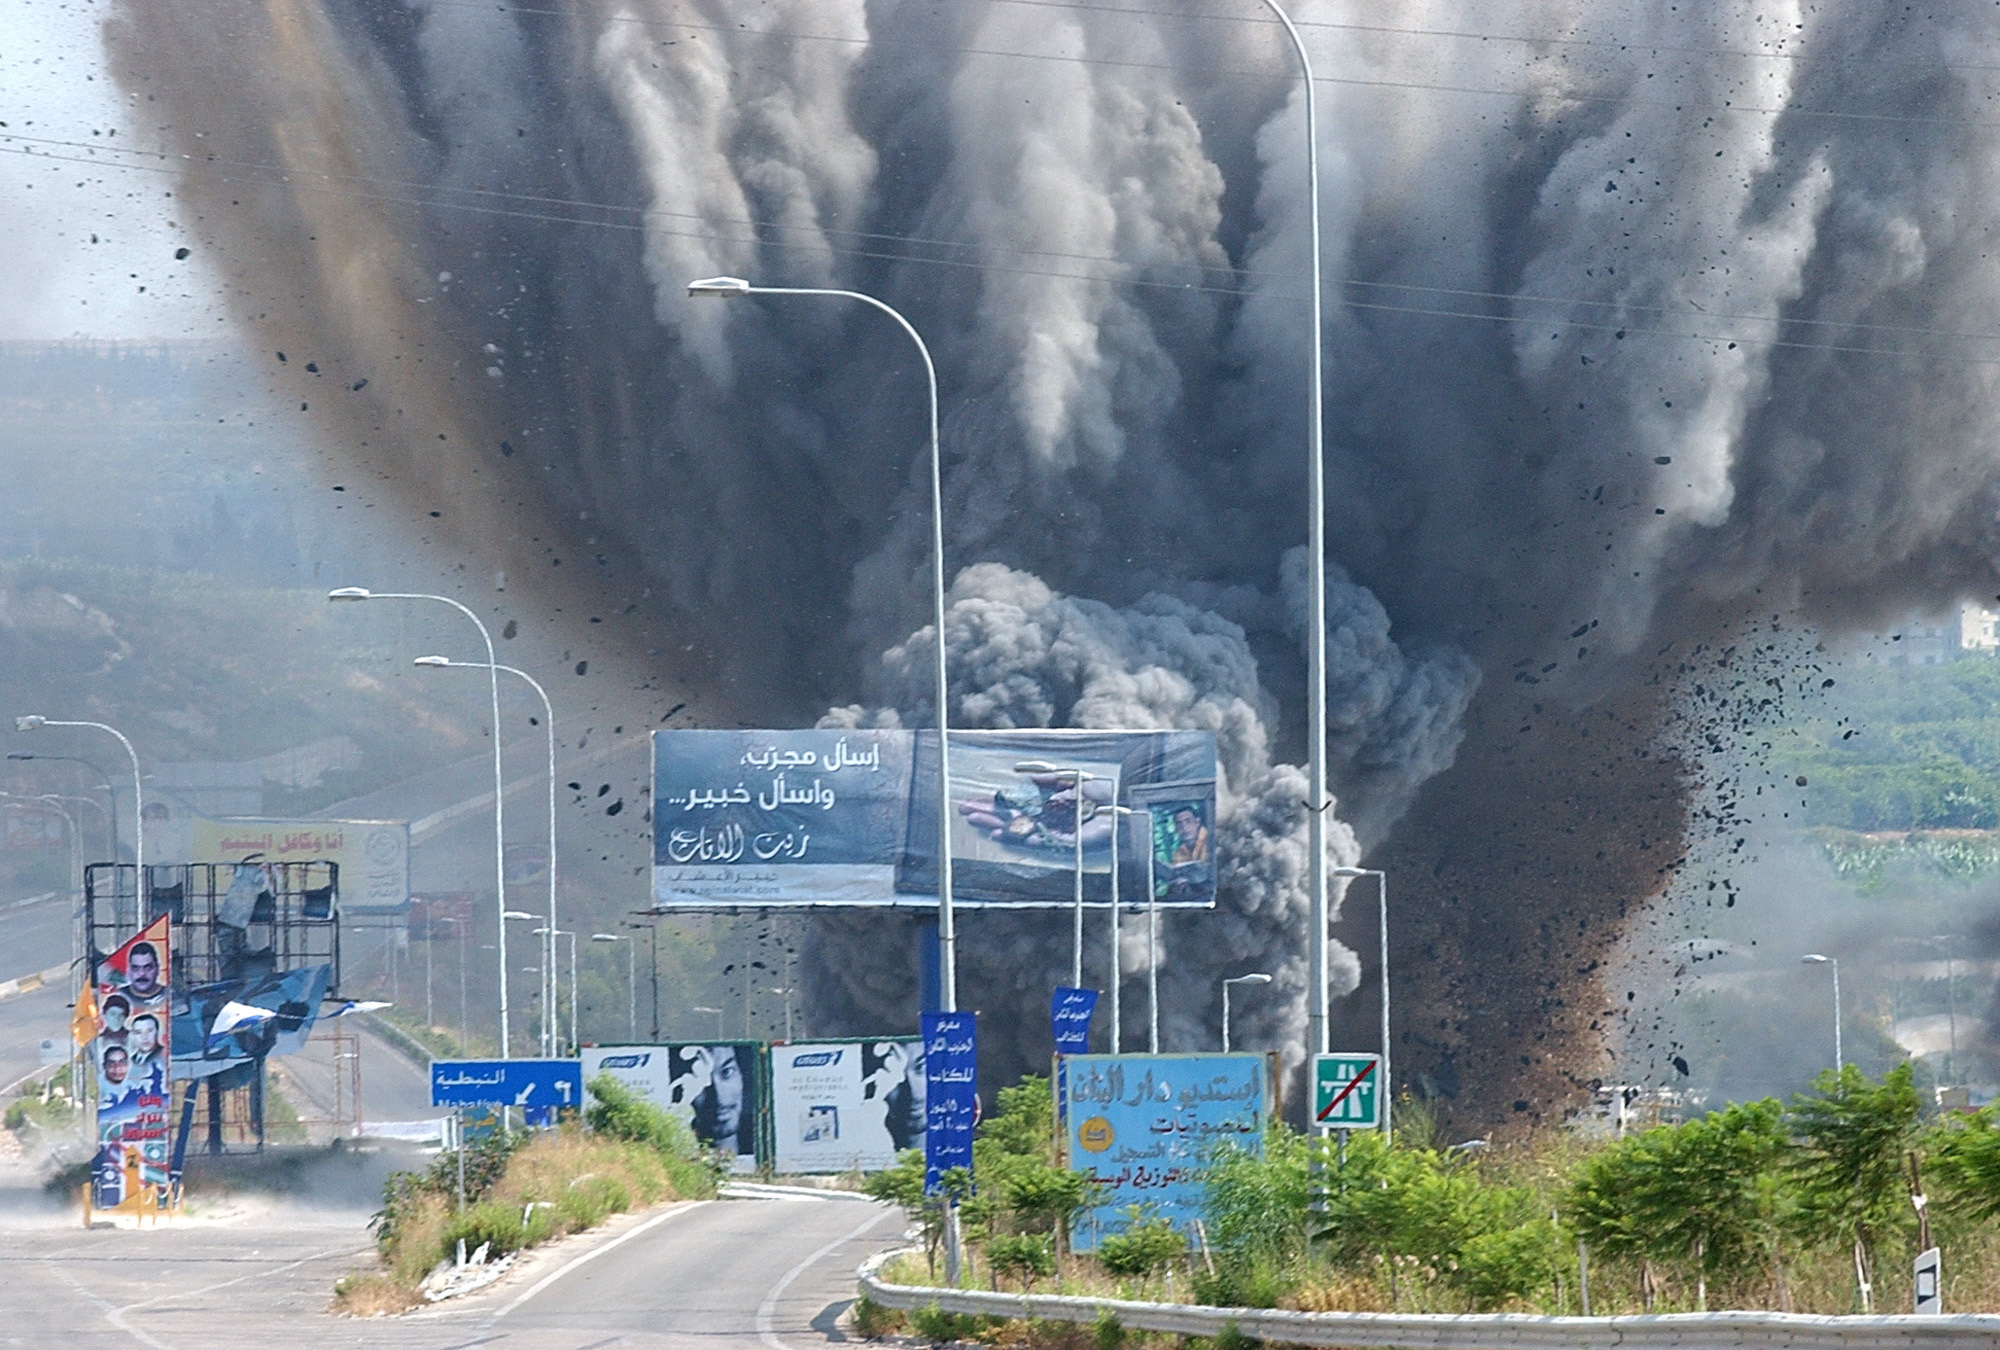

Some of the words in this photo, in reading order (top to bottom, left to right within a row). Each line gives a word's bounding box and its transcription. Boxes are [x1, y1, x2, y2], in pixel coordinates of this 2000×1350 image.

[823, 736, 880, 771] إسأل
[758, 772, 836, 811] واسأل
[436, 1068, 506, 1090] النبطية
